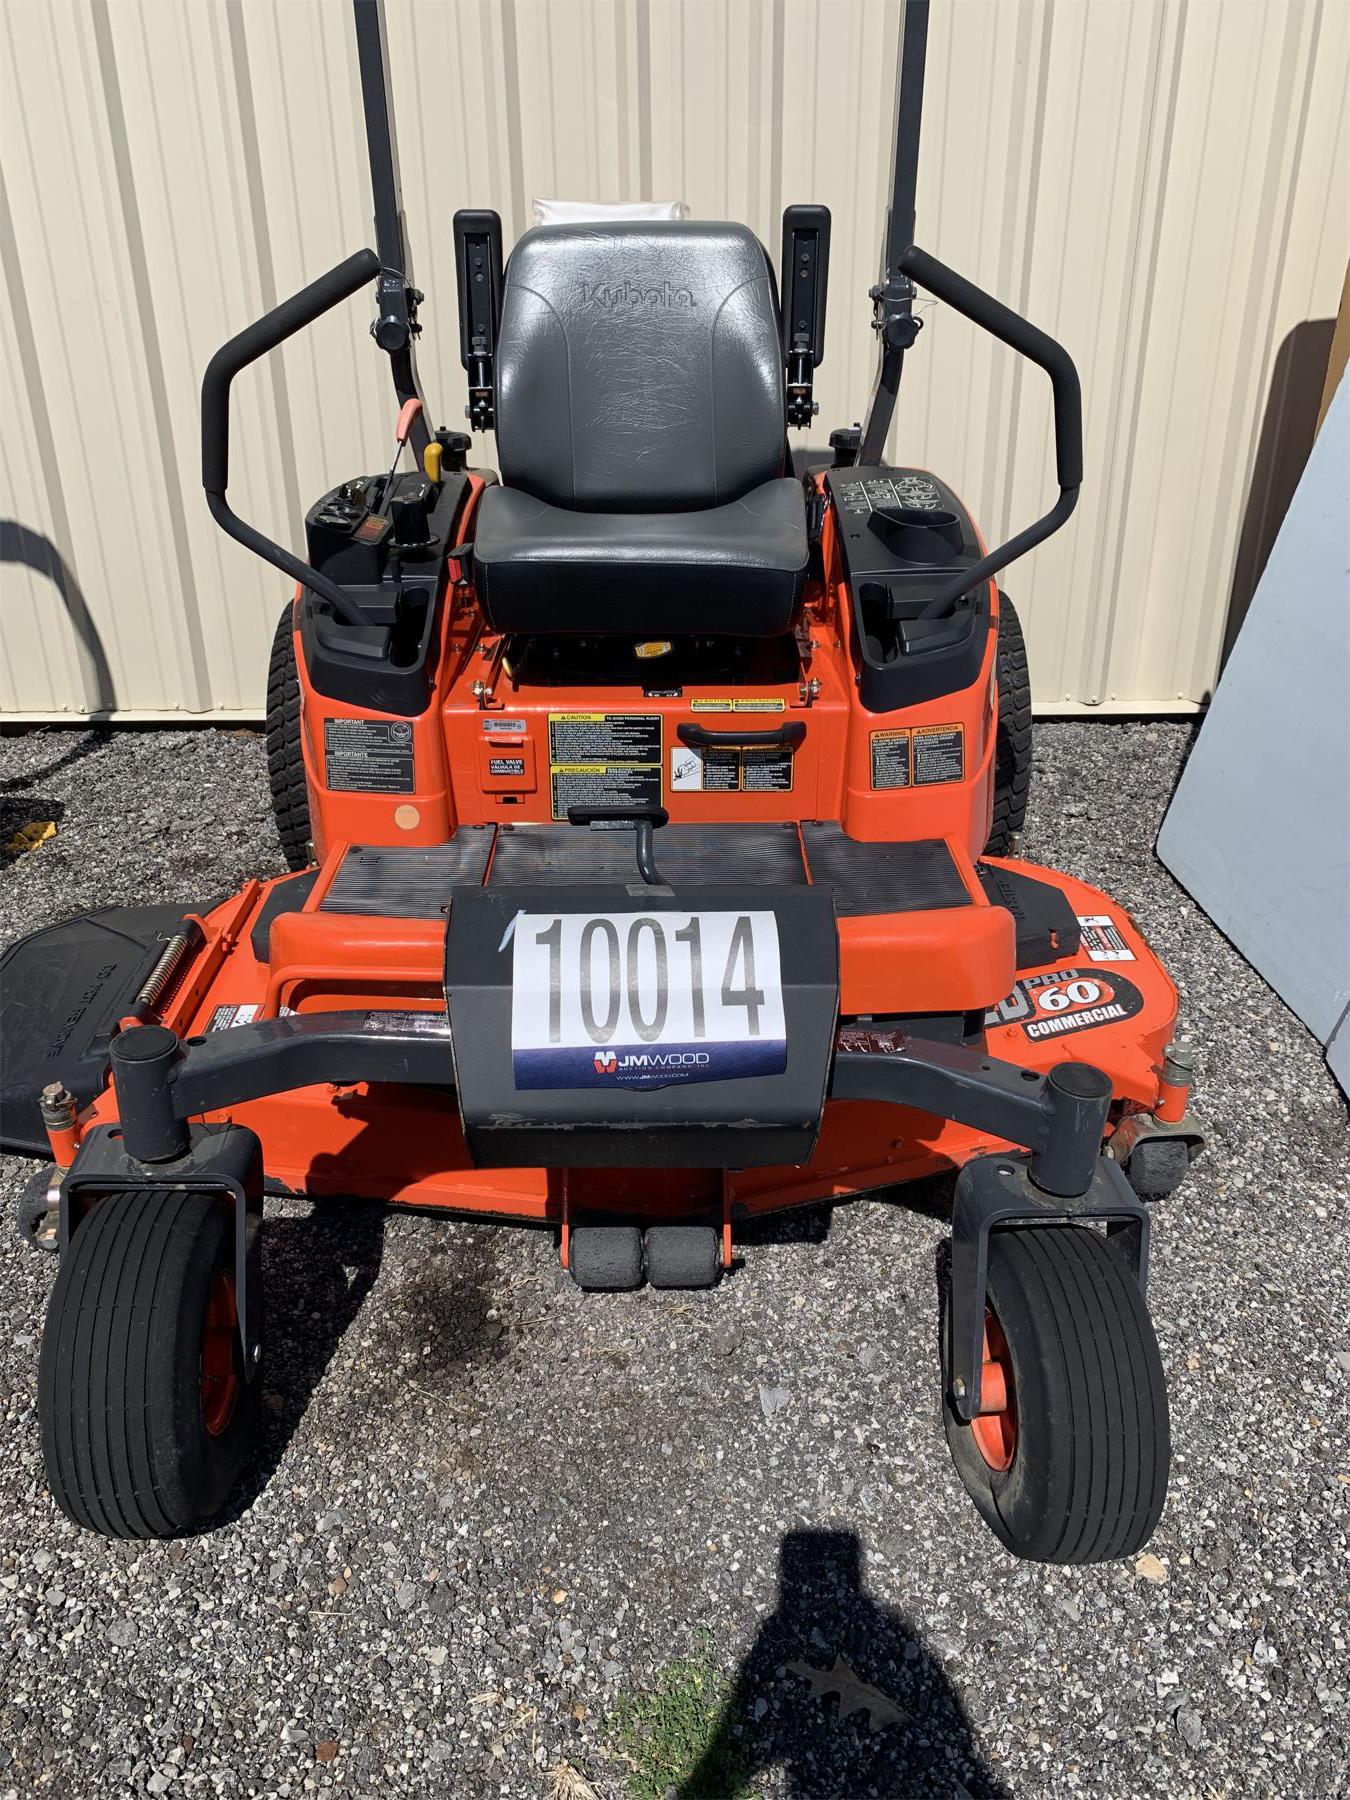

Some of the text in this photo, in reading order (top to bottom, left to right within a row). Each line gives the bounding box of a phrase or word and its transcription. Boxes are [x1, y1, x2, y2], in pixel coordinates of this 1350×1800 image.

[583, 281, 697, 309] Kubota
[921, 725, 959, 735] ADVERTENCIA
[334, 750, 369, 759] IMPORTANTE
[535, 916, 765, 1043] 10014
[1023, 968, 1080, 991] PRO
[1038, 981, 1100, 1011] 60
[1027, 1004, 1127, 1038] COMMERCIAL
[618, 1053, 710, 1067] JMWOOD
